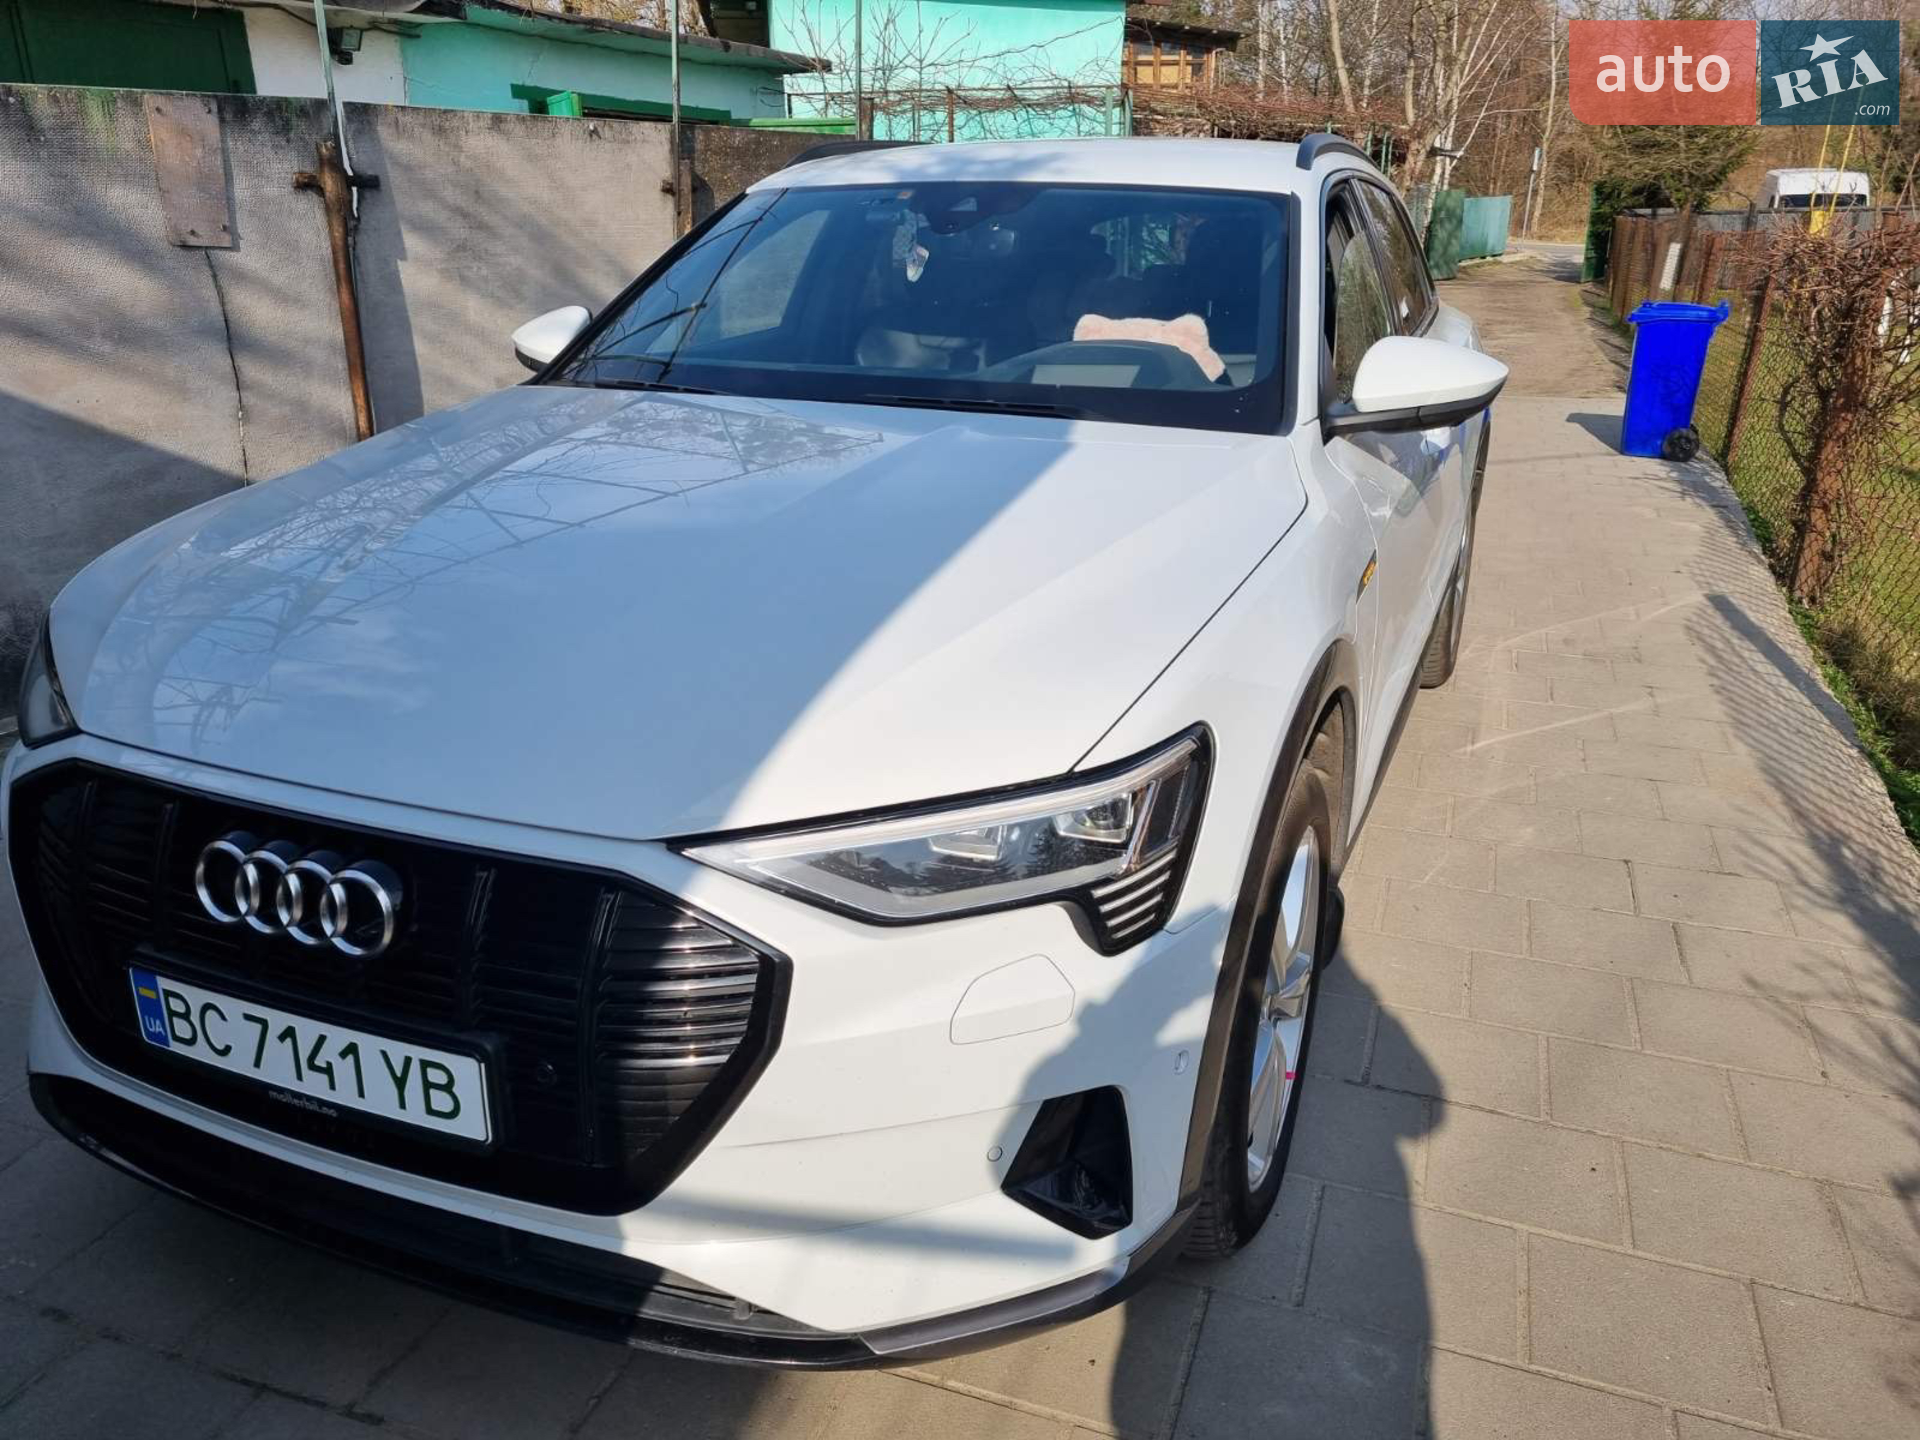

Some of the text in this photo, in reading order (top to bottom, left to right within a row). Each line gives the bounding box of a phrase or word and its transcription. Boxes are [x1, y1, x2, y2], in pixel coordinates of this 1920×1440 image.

[144, 1015, 166, 1036] UA
[163, 989, 462, 1121] BC 7141 YB
